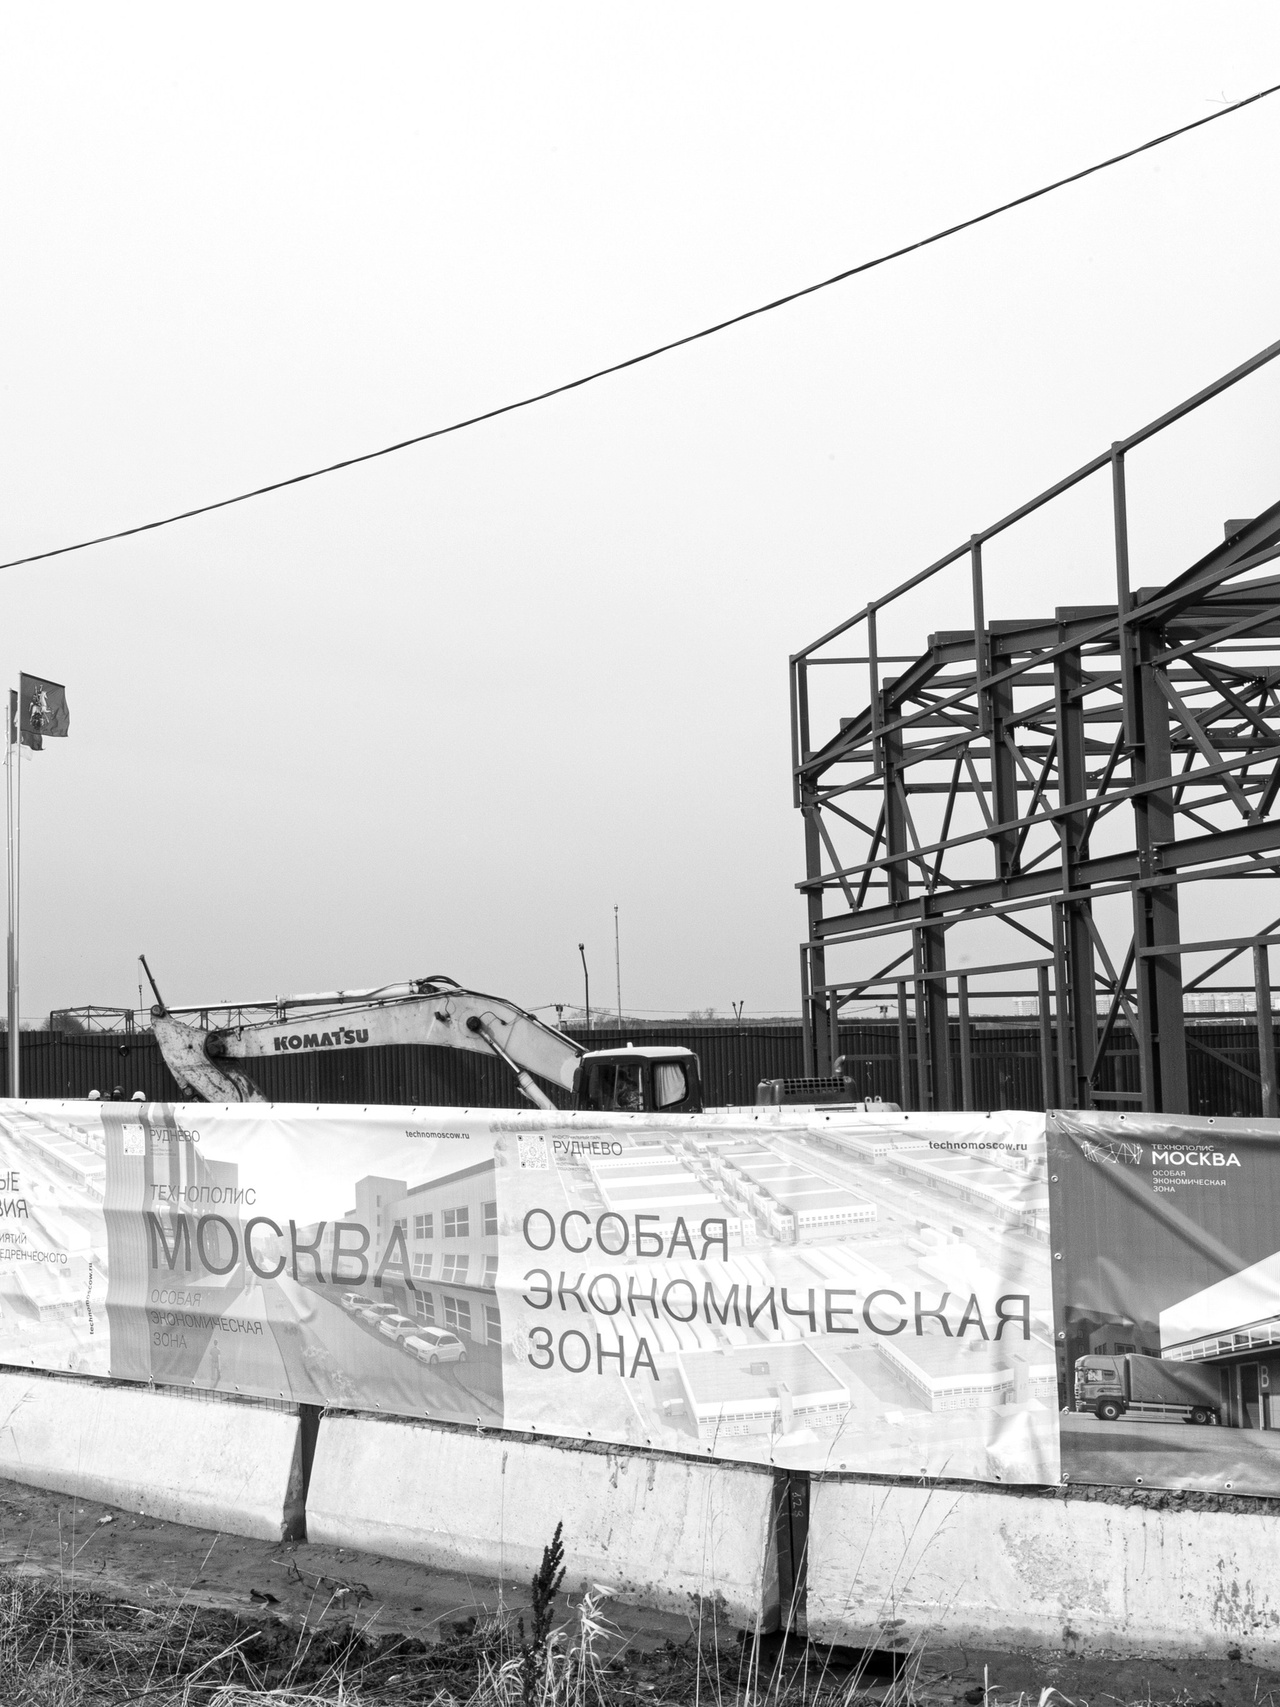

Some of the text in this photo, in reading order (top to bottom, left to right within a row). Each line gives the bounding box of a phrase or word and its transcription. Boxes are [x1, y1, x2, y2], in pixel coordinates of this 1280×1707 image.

[274, 1027, 369, 1051] KOMATSU
[150, 1129, 200, 1143] РУДНЕВО
[405, 1130, 470, 1139] technomoscow.ru
[553, 1140, 623, 1157] РУДНЕВО
[928, 1141, 1028, 1151] technomoscow.ru
[1151, 1143, 1215, 1151] ТЕХНОПОЛИС
[1151, 1151, 1242, 1167] МОСКВА
[1152, 1178, 1227, 1186] ЭКОНОМИЧЕСКАЯ
[1153, 1185, 1176, 1193] ЗОНА
[150, 1184, 257, 1206] ТЕХНОПОЛИС
[522, 1208, 729, 1261] ОСОБАЯ
[147, 1211, 417, 1291] МОСКВА
[151, 1289, 202, 1307] ОСОБАЯ
[522, 1269, 1031, 1341] ЭКОНОМИЧЕСКАЯ
[151, 1311, 264, 1335] ЭКОНОМИЧЕСКАЯ
[153, 1332, 188, 1349] ЗОНА
[527, 1326, 660, 1381] ЗОНА
